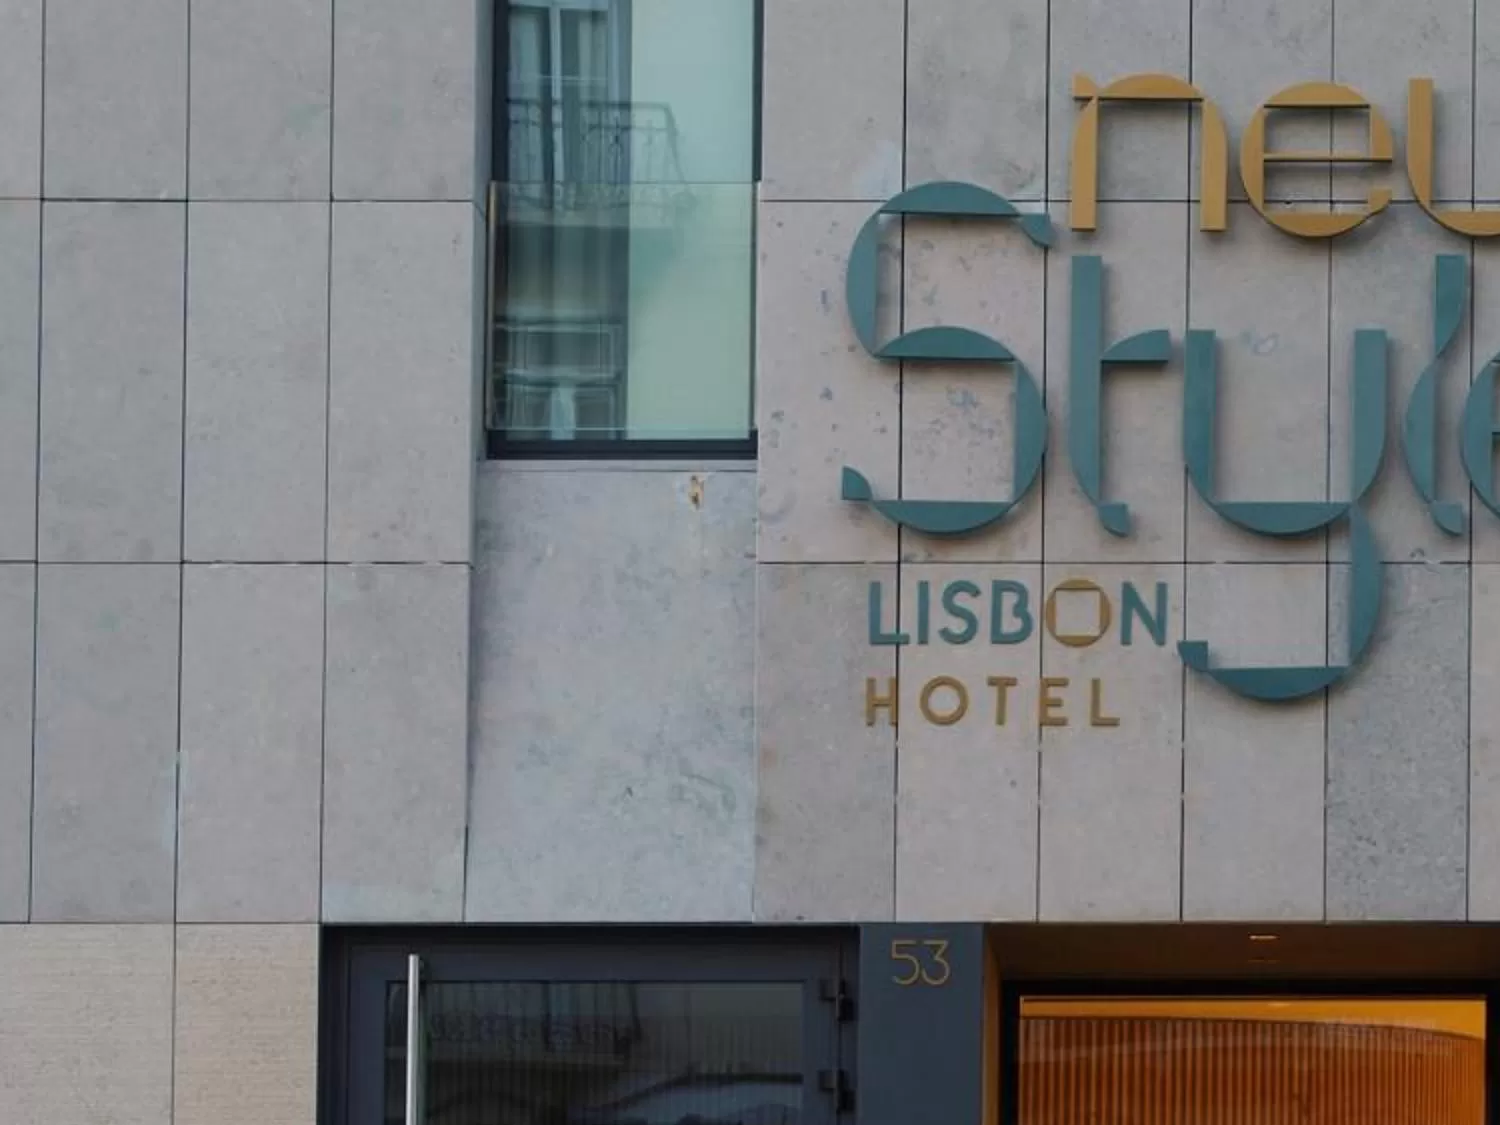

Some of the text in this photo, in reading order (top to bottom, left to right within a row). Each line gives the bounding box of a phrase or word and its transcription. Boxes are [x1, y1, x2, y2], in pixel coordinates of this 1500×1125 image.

[868, 580, 1169, 647] LISBON
[865, 677, 1121, 727] HOTEL
[891, 940, 951, 985] 53
